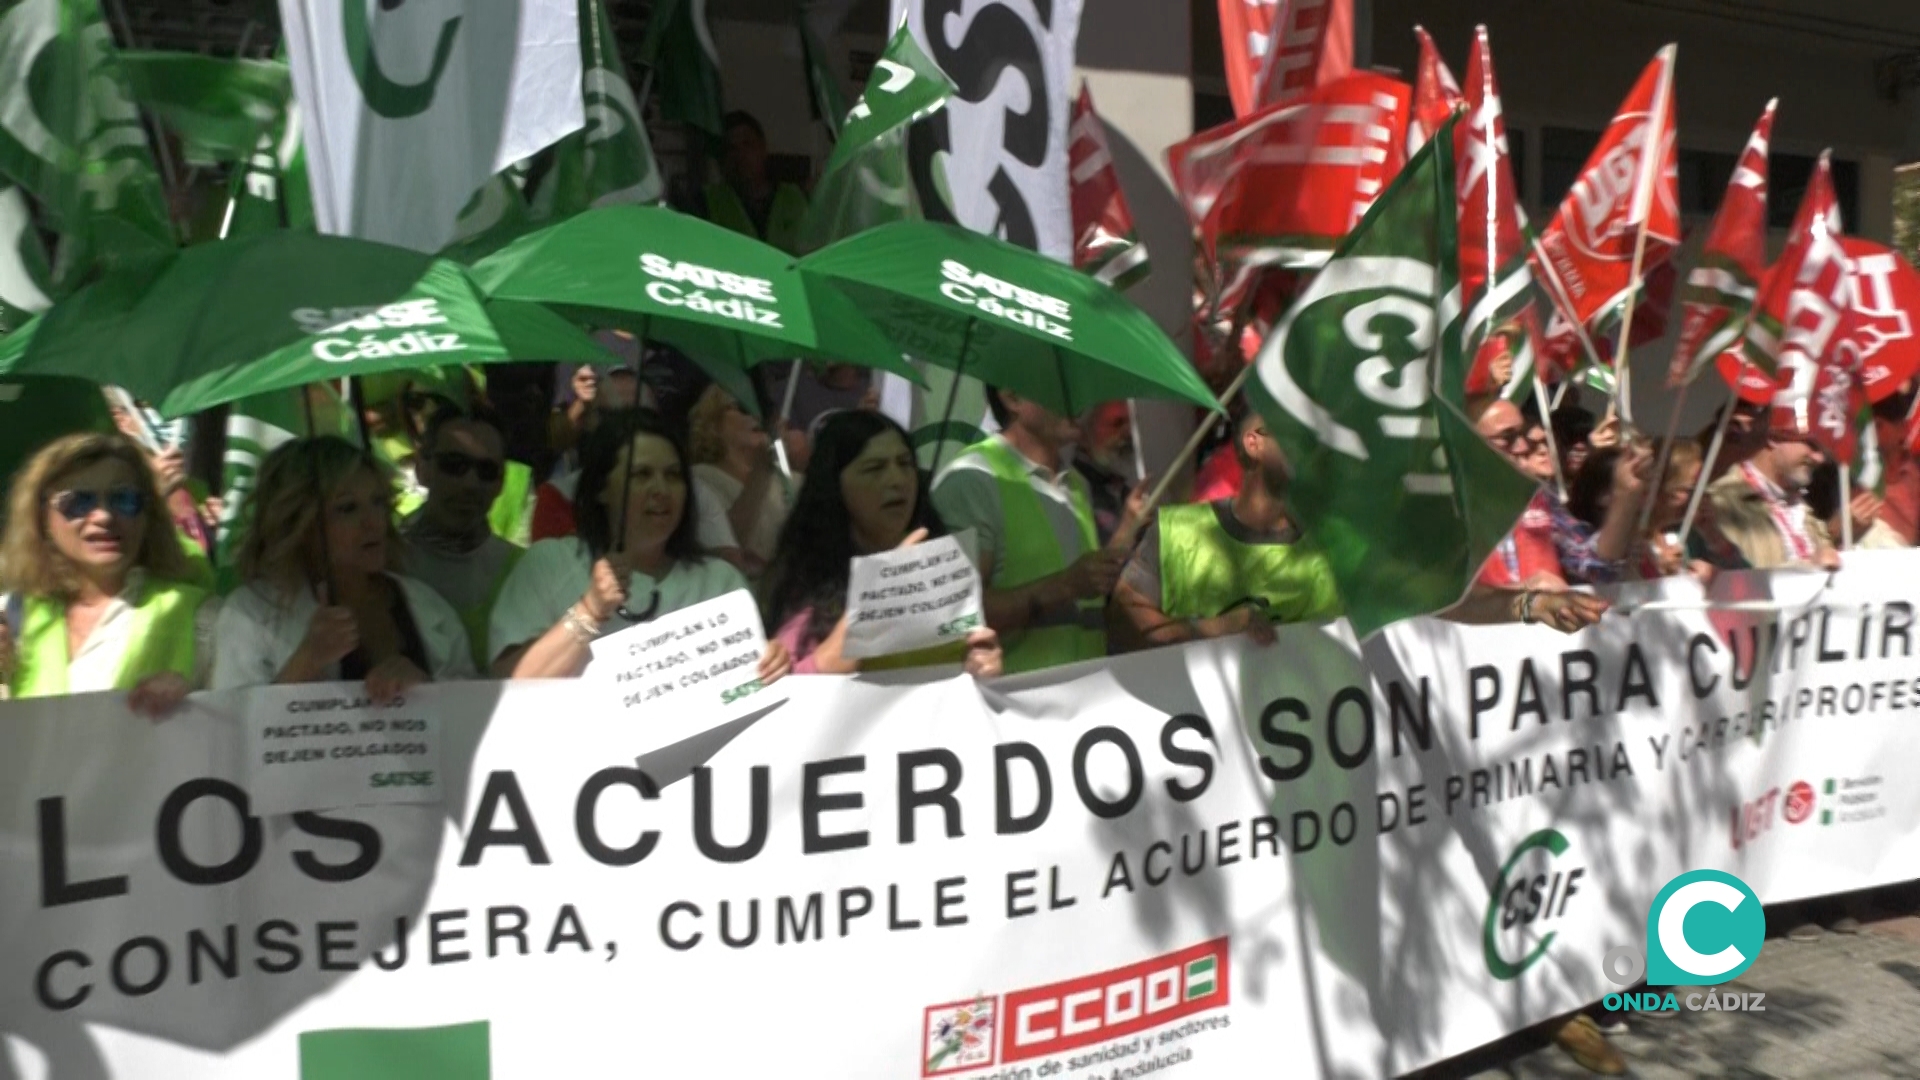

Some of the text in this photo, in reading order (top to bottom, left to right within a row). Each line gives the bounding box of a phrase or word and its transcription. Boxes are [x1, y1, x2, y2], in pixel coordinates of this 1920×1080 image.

[640, 252, 778, 303] SATSE
[939, 259, 1072, 321] SATSE
[290, 297, 448, 334] SATSE
[645, 281, 784, 329] Cádiz
[939, 282, 1074, 341] Cádiz
[312, 329, 469, 363] Cádiz
[707, 612, 729, 628] LO
[696, 640, 719, 656] NO
[358, 719, 387, 732] NO
[390, 719, 428, 732] NOS
[37, 777, 381, 908] LOS
[457, 713, 1220, 868] ACUERDOS
[1258, 675, 1432, 781] SON
[1468, 643, 1660, 740] PARA
[263, 743, 428, 765] DEJEN COLGADOS
[369, 771, 435, 788] SATSE
[34, 903, 618, 1011] CONSEJERA,
[658, 877, 969, 951] CUMPLE
[1005, 864, 1076, 919] EL
[1102, 802, 1357, 898] ACUERDO
[1377, 783, 1428, 834] DE
[1445, 742, 1634, 806] PRIMARIA
[1648, 734, 1671, 771] Y
[1503, 867, 1584, 930] CSIF
[1015, 965, 1180, 1047] CCOO
[1036, 1059, 1062, 1078] de
[1067, 1037, 1141, 1071] sanidad
